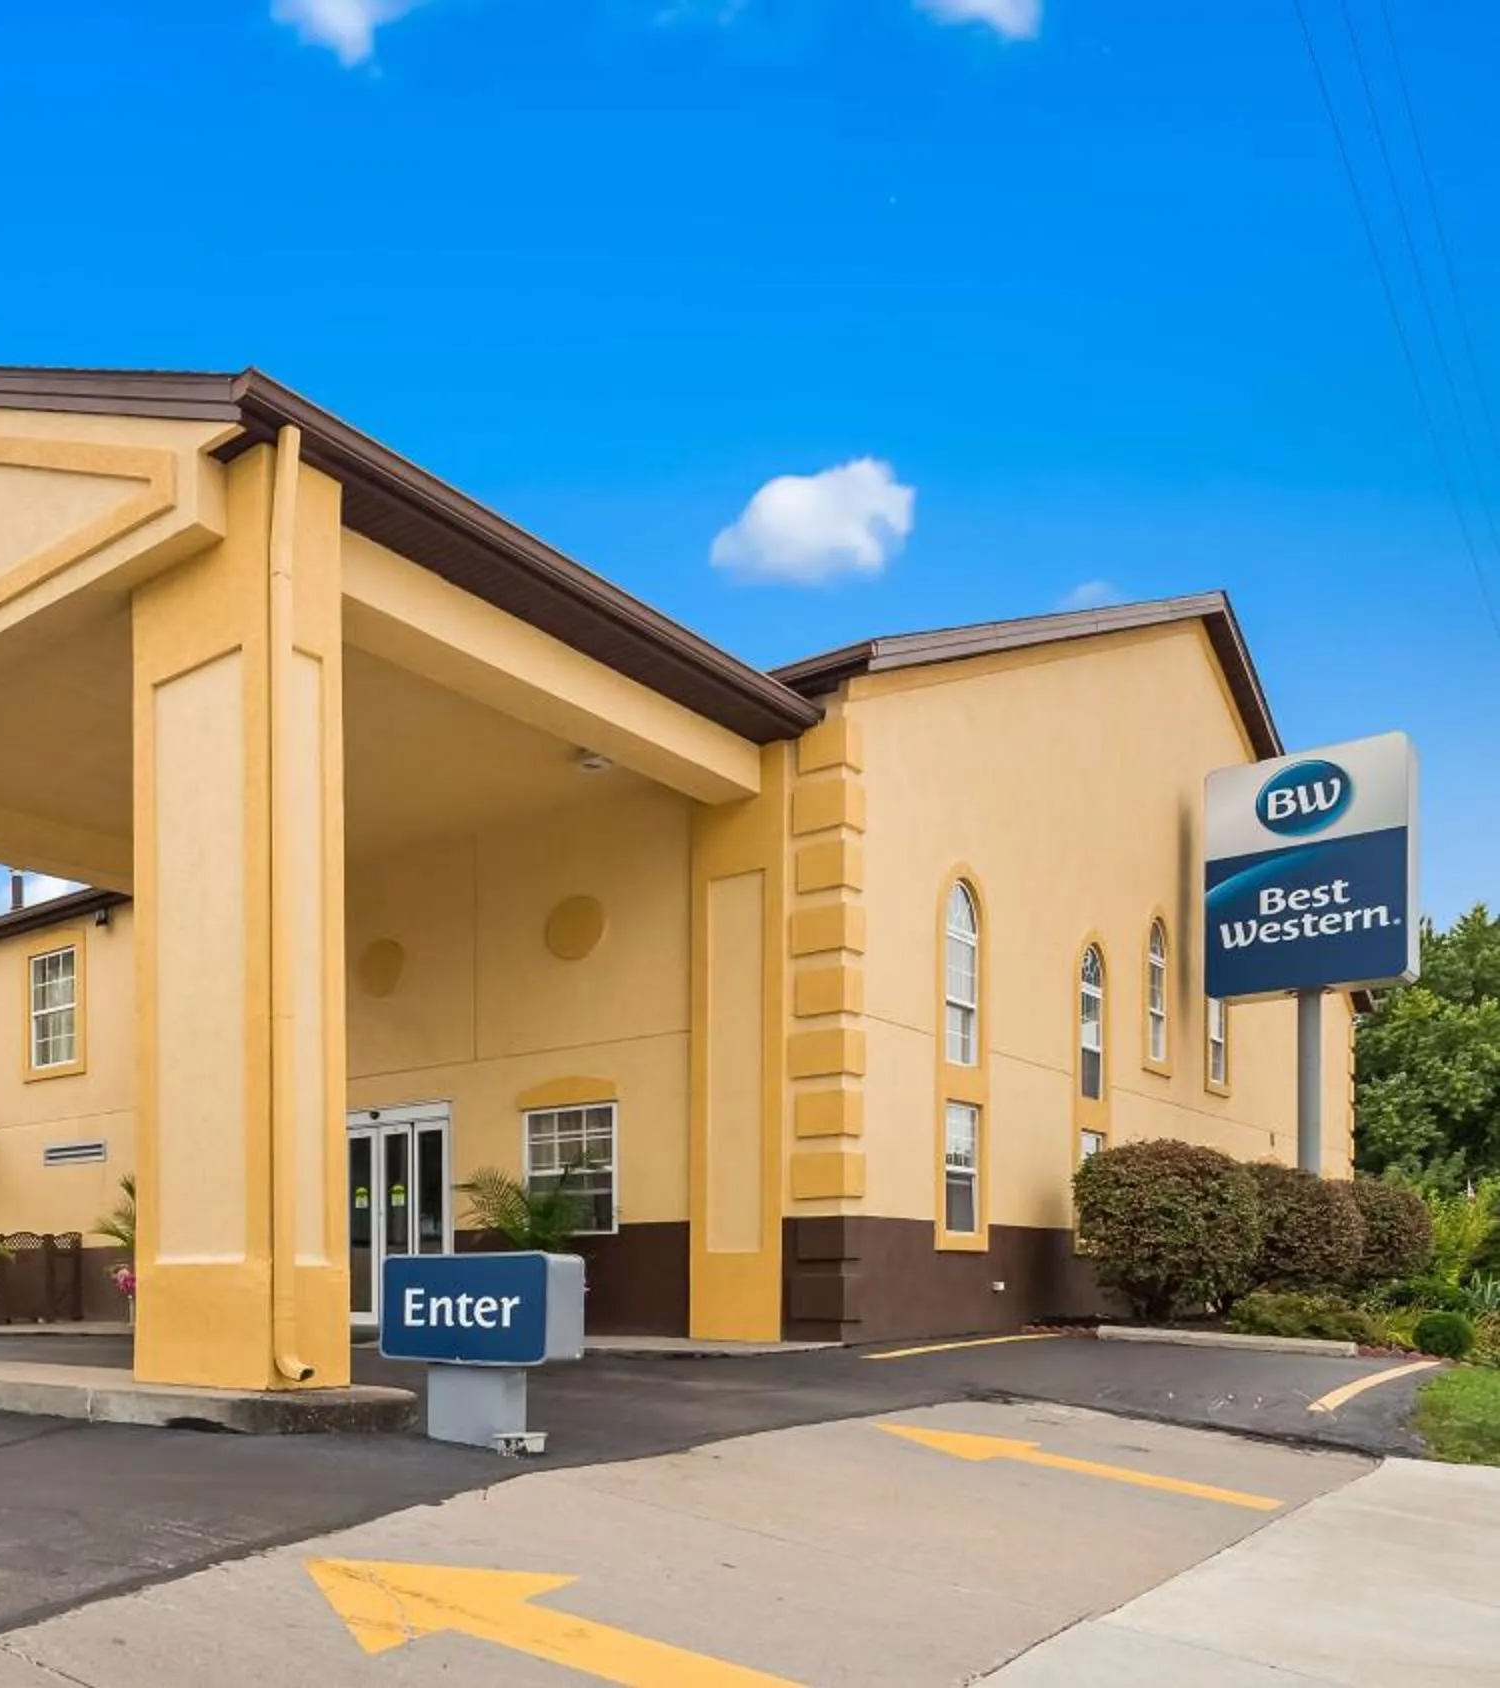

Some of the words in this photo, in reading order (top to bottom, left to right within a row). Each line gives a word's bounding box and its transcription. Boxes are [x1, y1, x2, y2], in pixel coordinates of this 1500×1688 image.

[1267, 778, 1341, 820] BW
[1260, 879, 1351, 915] Best
[403, 1287, 520, 1328] Enter
